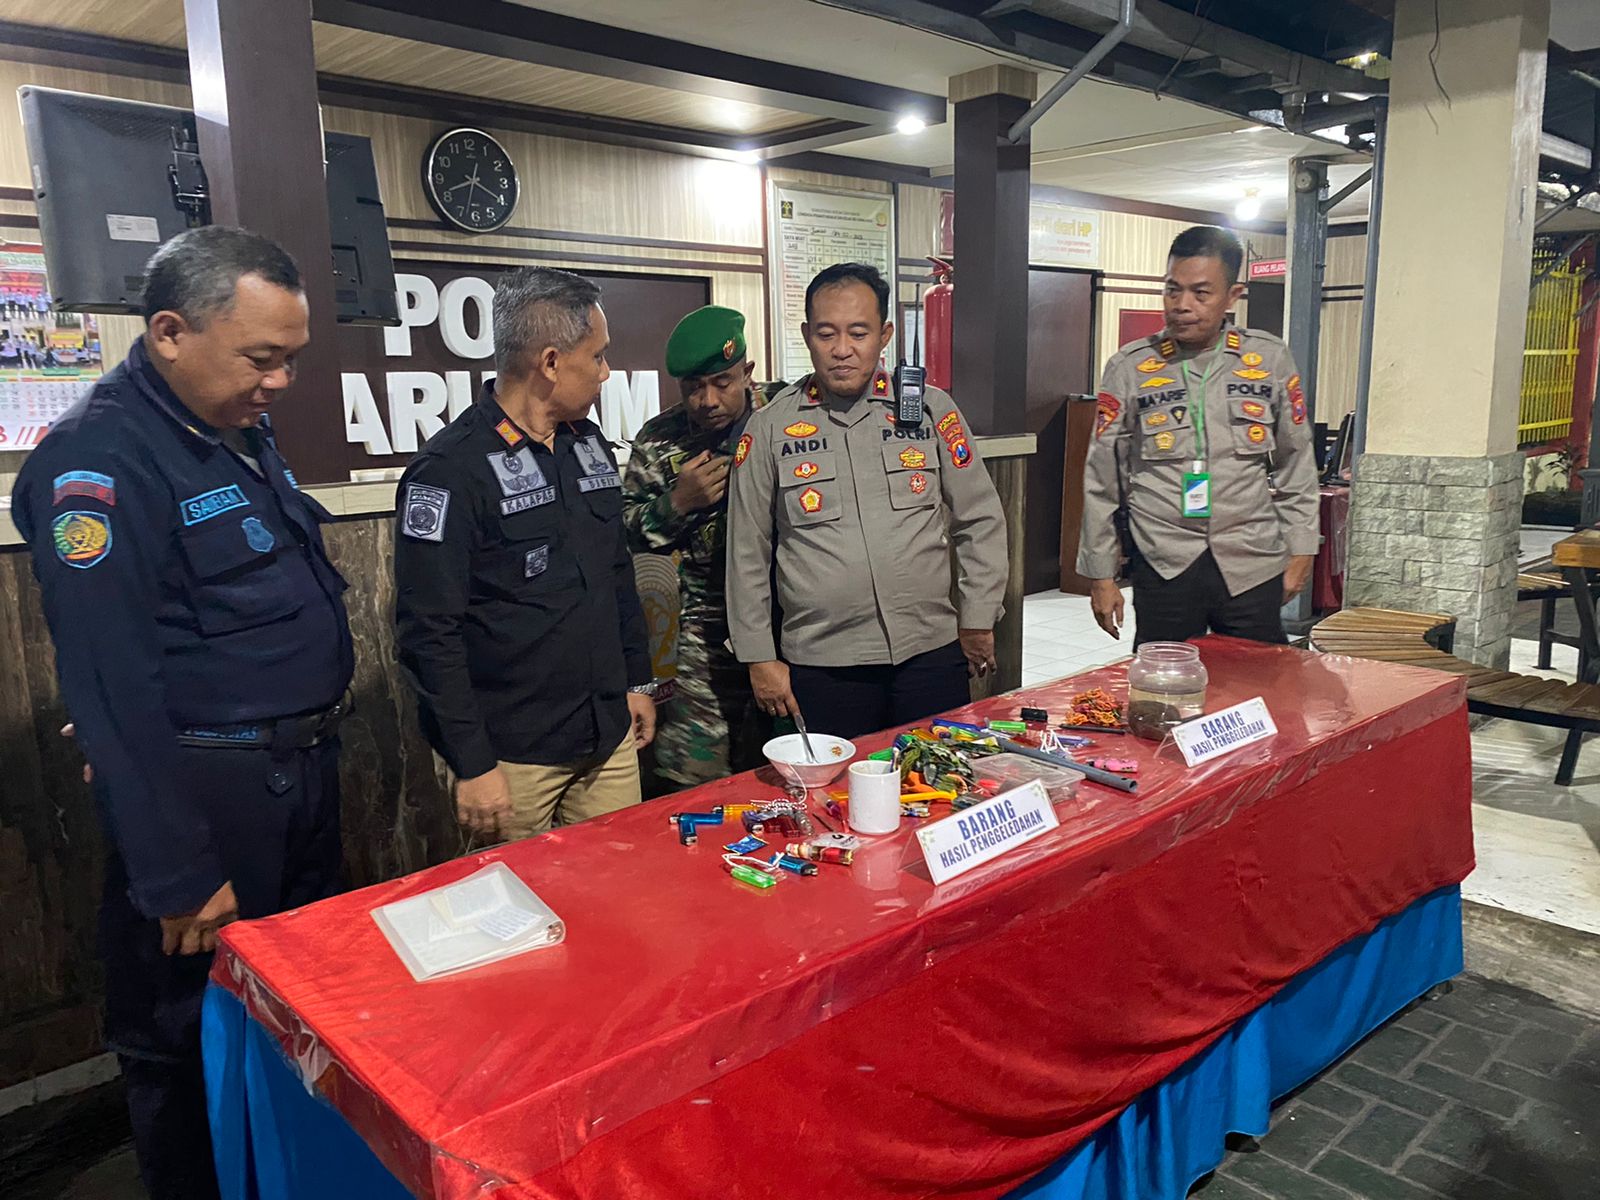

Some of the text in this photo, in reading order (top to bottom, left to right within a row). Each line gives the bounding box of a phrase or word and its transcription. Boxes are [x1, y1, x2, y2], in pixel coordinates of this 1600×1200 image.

[449, 142, 459, 154] 11
[463, 138, 475, 150] 12
[439, 156, 451, 168] 10
[493, 160, 502, 172] 2
[435, 173, 444, 184] 9
[500, 178, 508, 189] 3
[443, 191, 453, 203] 8
[457, 206, 464, 217] 7
[471, 211, 480, 222] 6
[486, 207, 495, 218] 5
[1078, 221, 1092, 237] HP
[1253, 263, 1287, 274] RUANG PELAYA
[384, 273, 496, 360] PO
[1227, 383, 1273, 399] POLRI
[1137, 389, 1187, 409] MA'ARIF
[882, 428, 931, 441] POLRI
[781, 438, 828, 457] ANDI
[1201, 711, 1245, 739] BARANG
[1190, 720, 1267, 757] HASIL PENGGELEDAHAN
[957, 799, 1016, 840] BARANG
[939, 808, 1044, 869] HASIL PENGGELEDAHAN
